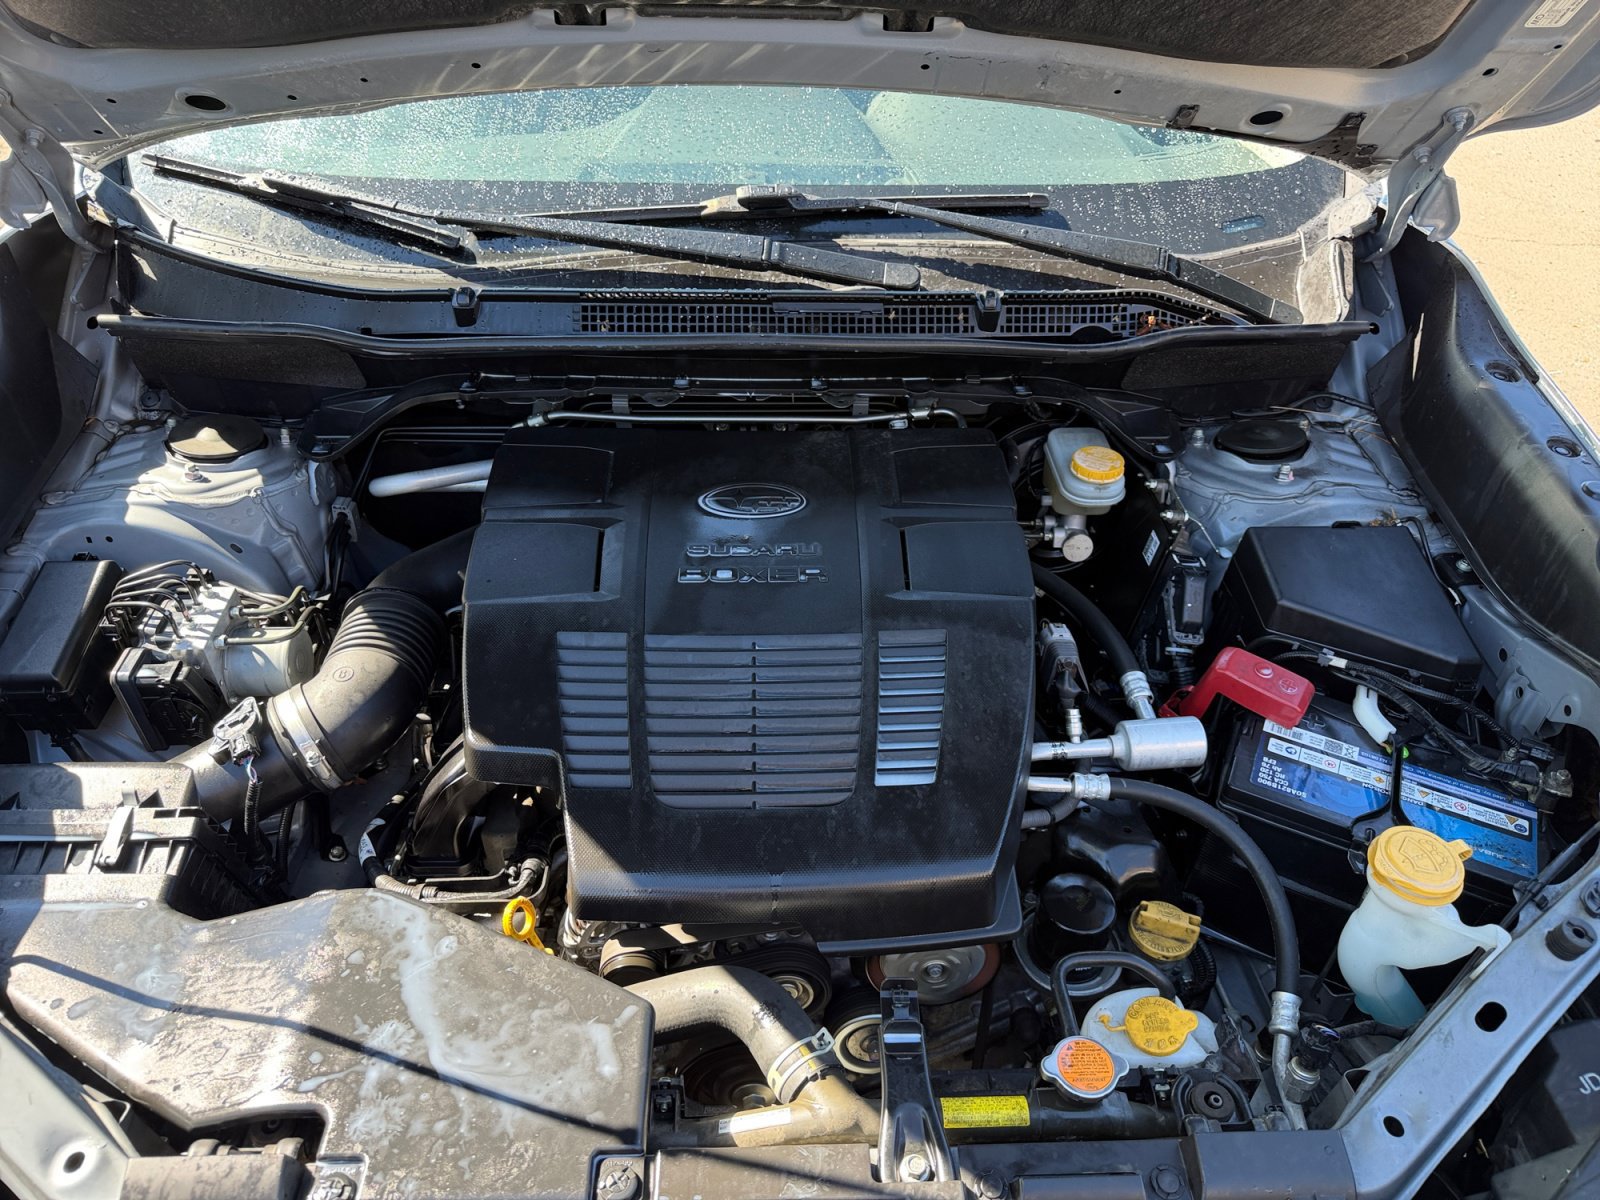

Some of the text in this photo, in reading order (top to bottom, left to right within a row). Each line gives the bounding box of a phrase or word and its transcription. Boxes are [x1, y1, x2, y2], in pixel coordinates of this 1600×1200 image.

[686, 542, 823, 557] SUBARU
[677, 566, 829, 584] BOXER
[1274, 771, 1285, 779] RC
[1273, 778, 1289, 786] CCA
